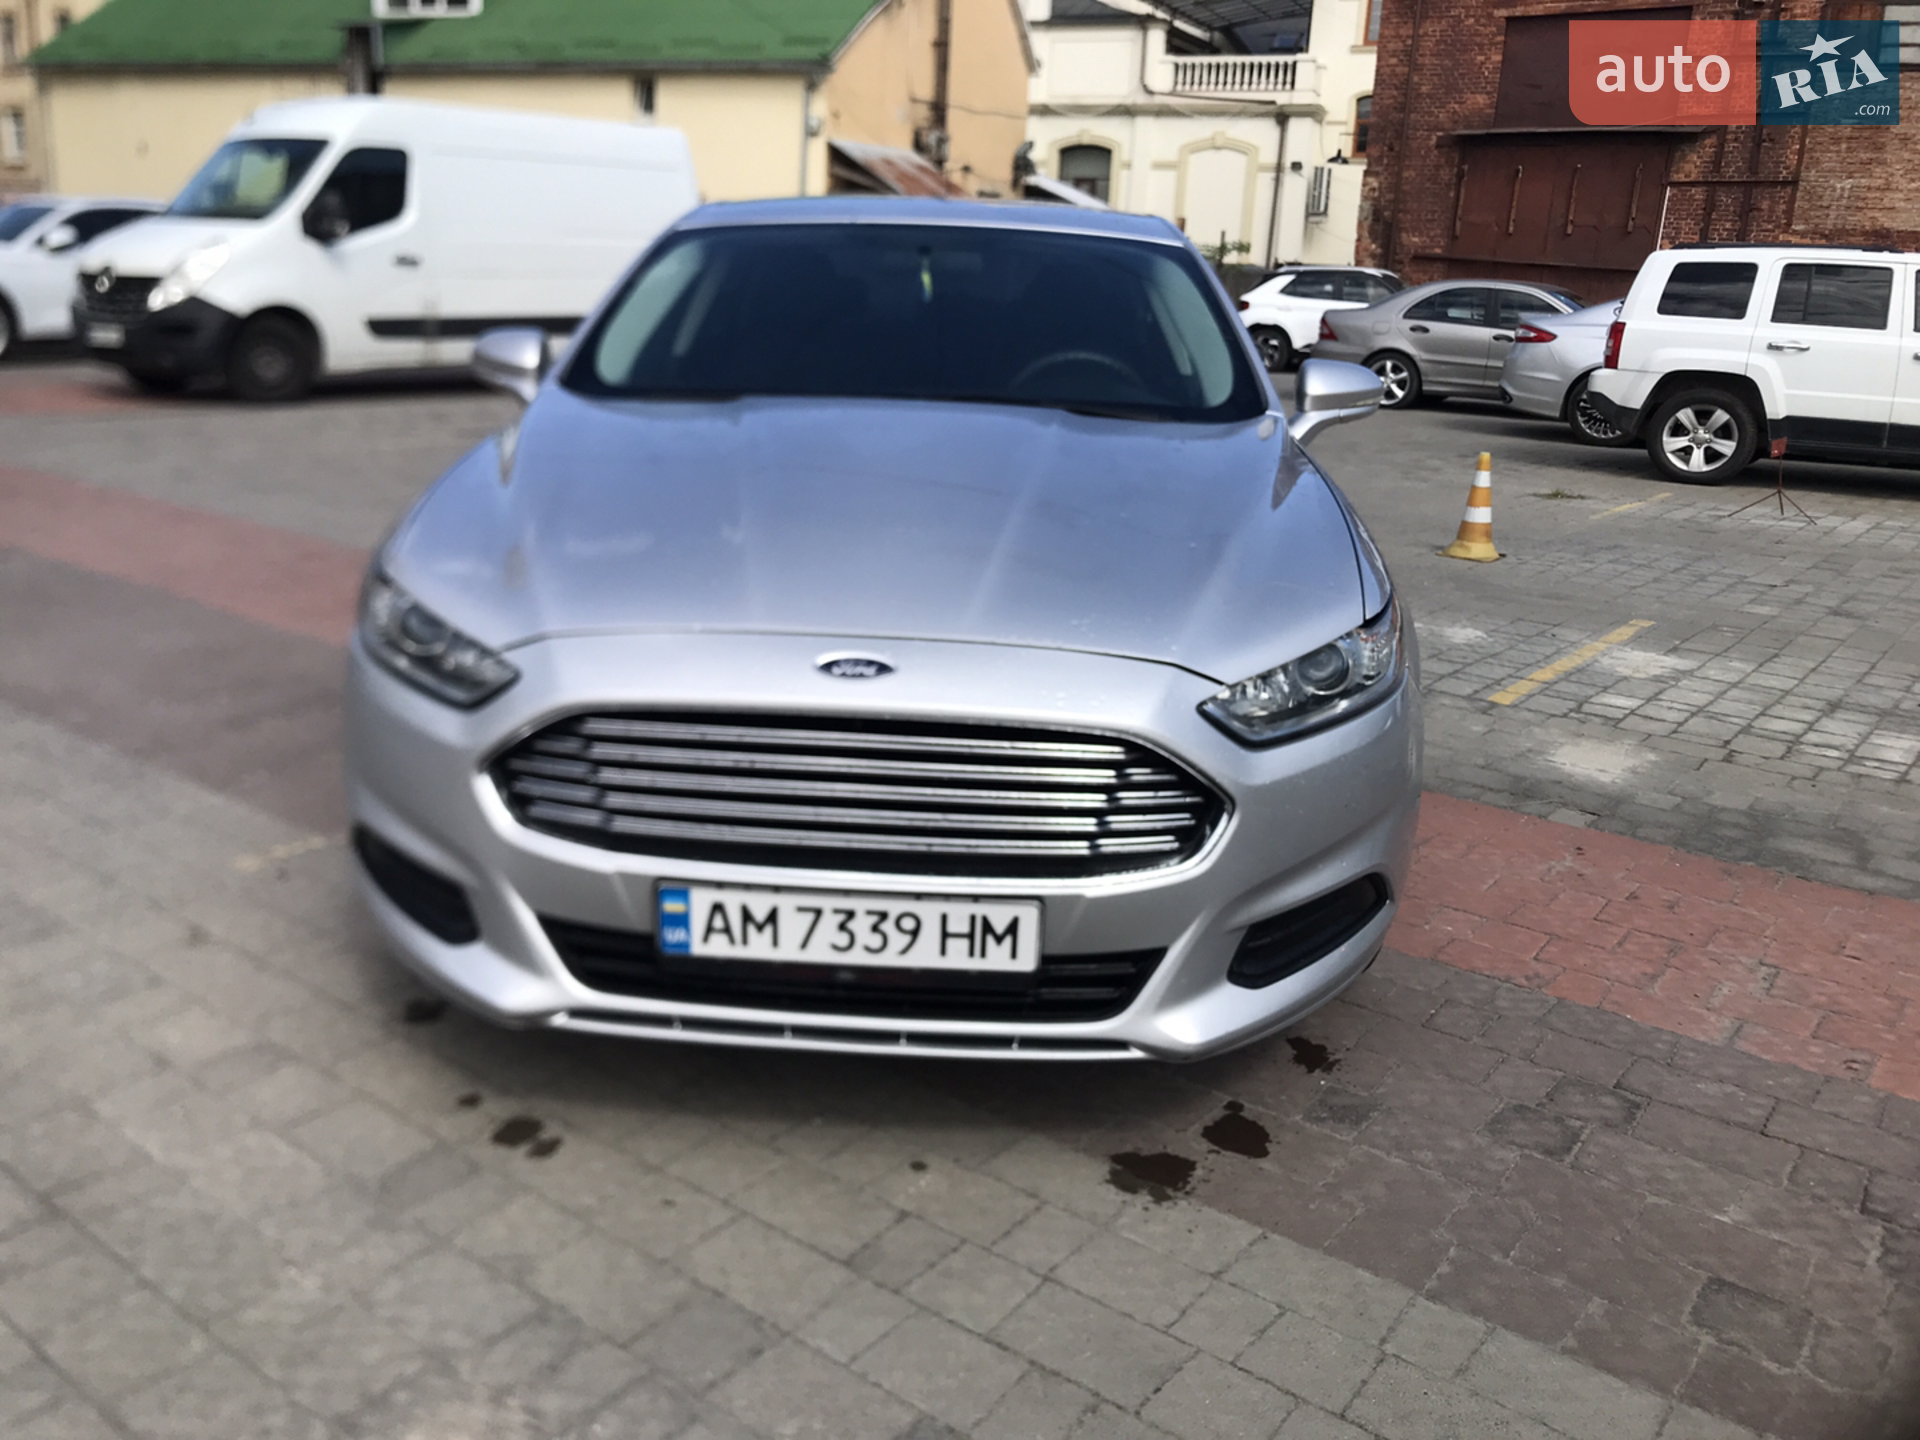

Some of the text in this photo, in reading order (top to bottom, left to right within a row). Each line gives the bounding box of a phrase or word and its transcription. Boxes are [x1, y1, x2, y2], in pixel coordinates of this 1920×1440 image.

[702, 901, 1020, 960] AM 7339 HM
